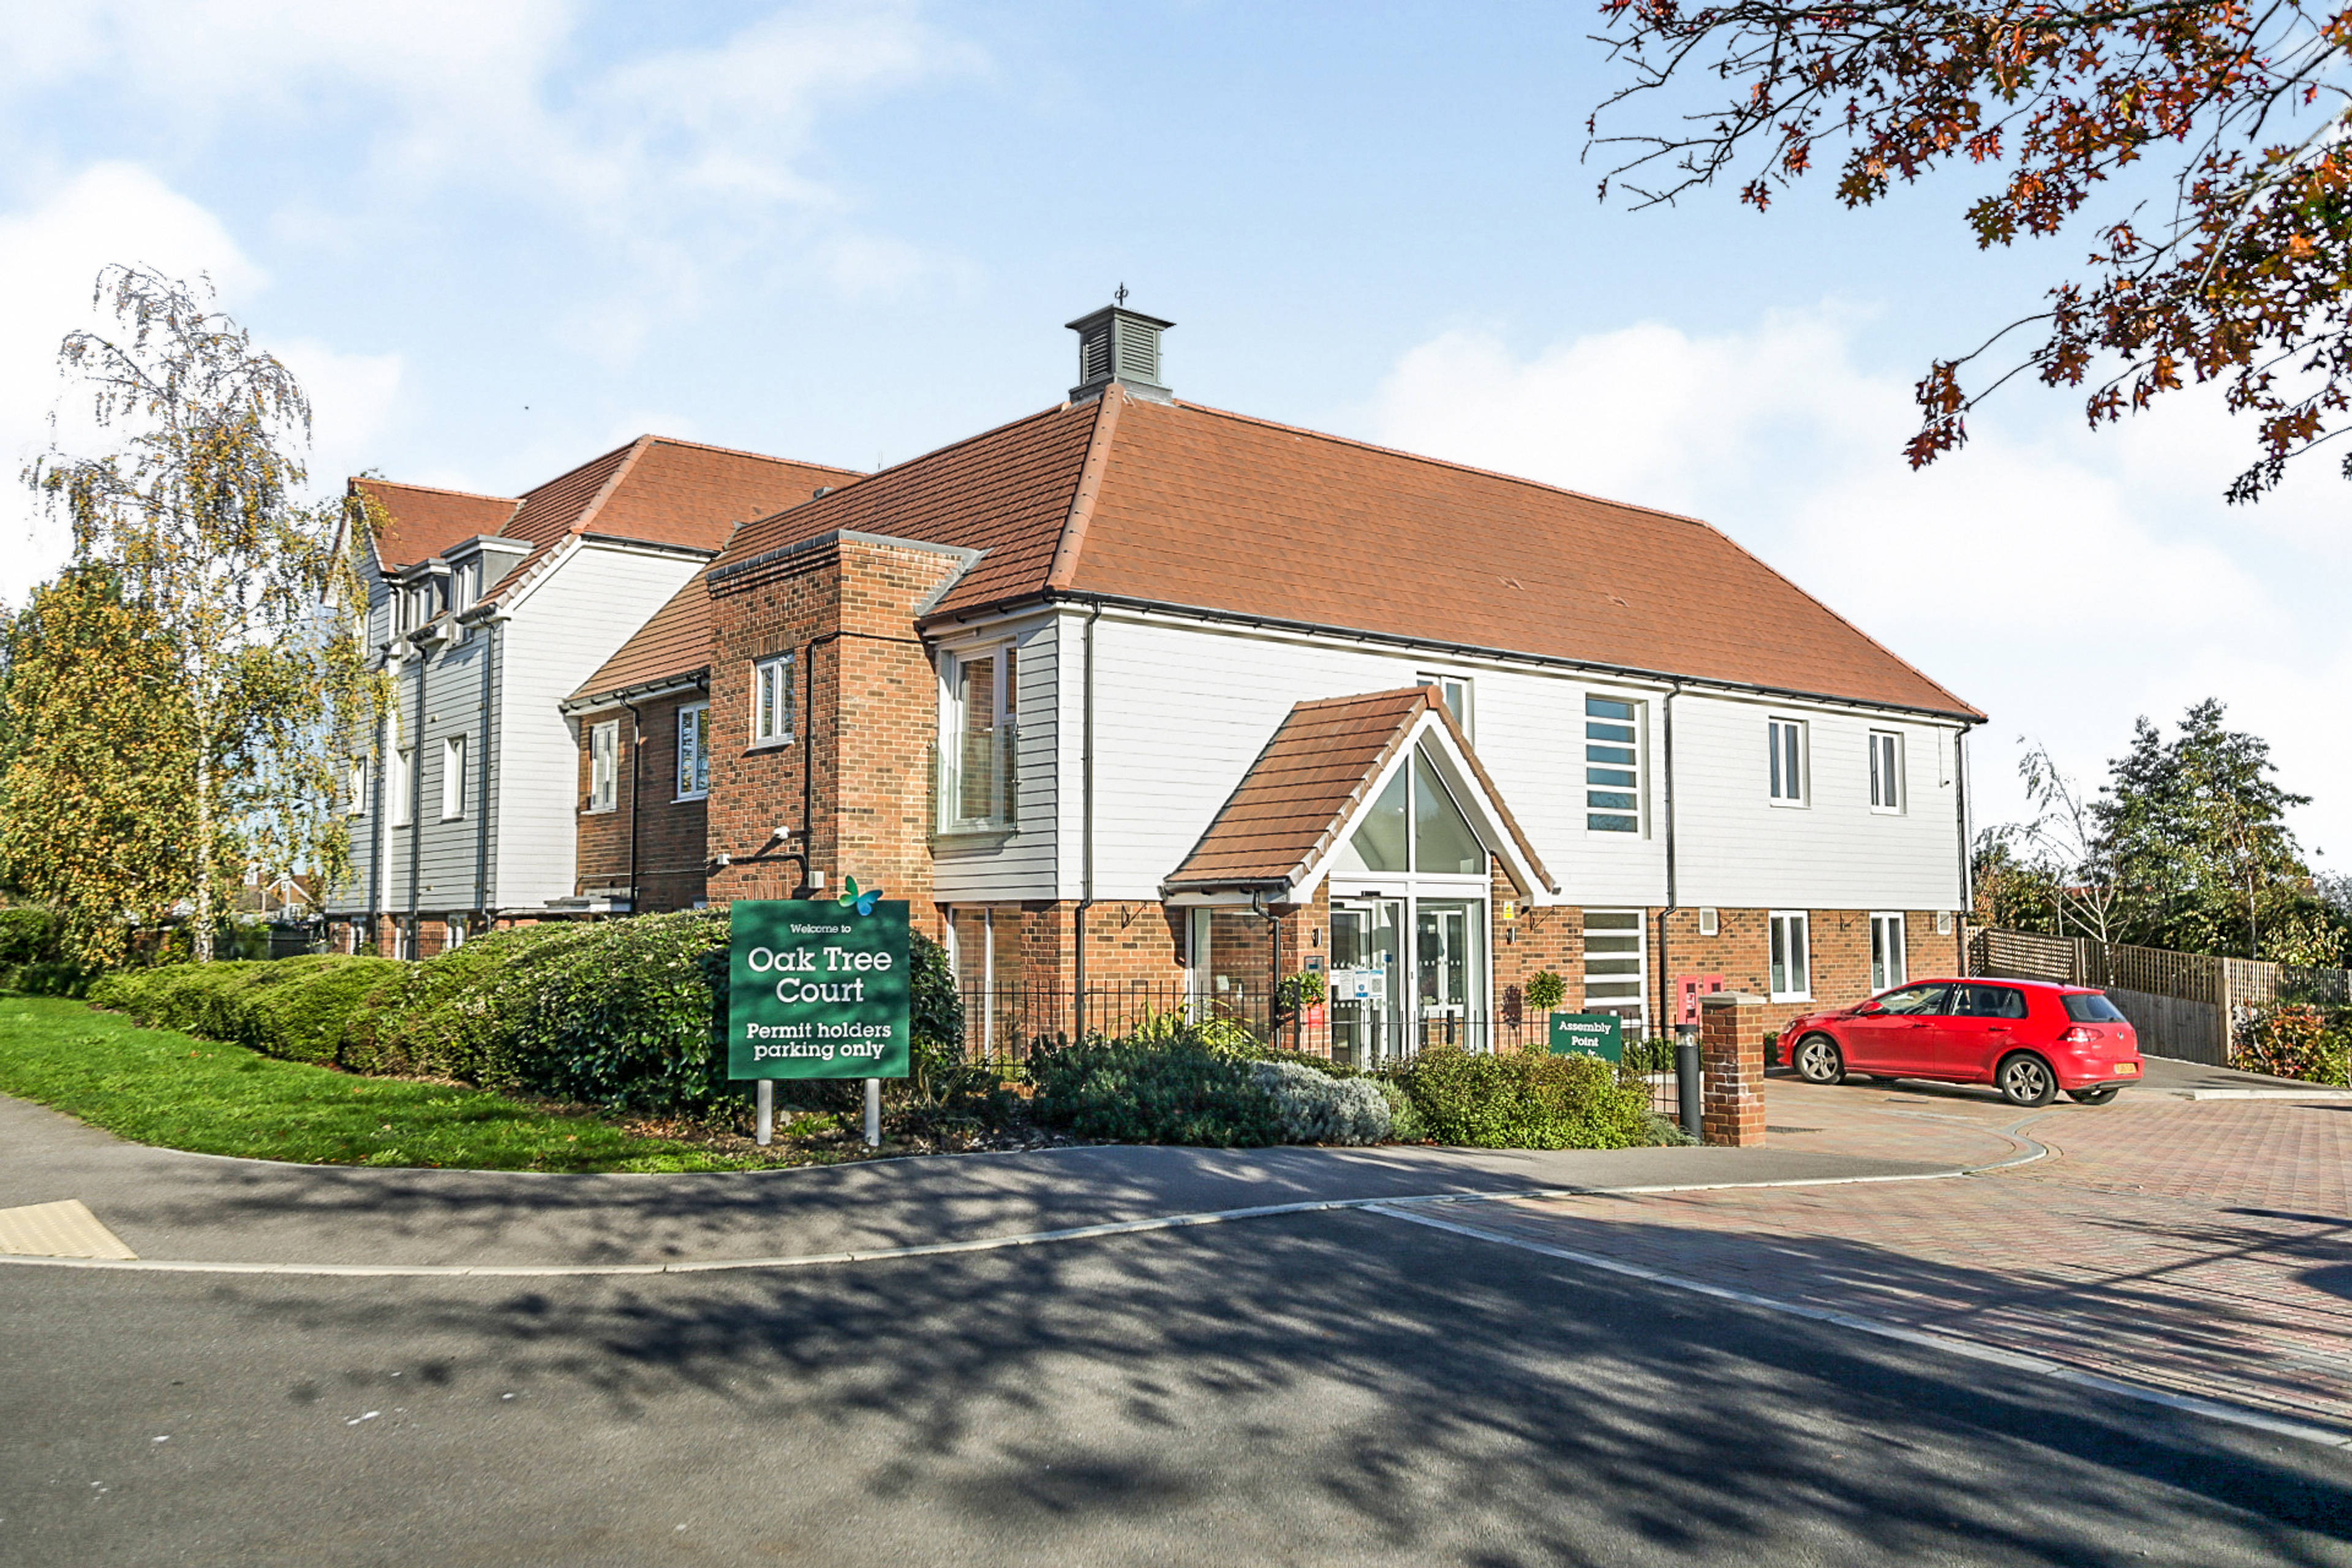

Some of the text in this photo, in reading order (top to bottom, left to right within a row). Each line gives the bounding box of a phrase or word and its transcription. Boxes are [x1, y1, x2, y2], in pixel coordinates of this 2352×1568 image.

[790, 924, 851, 933] Welcome to
[748, 946, 892, 972] Oak Tree
[776, 977, 864, 1003] Court
[746, 1022, 892, 1039] Permit holders
[1559, 1020, 1611, 1035] Assembly
[1572, 1035, 1599, 1047] Point
[753, 1041, 885, 1061] parking only
